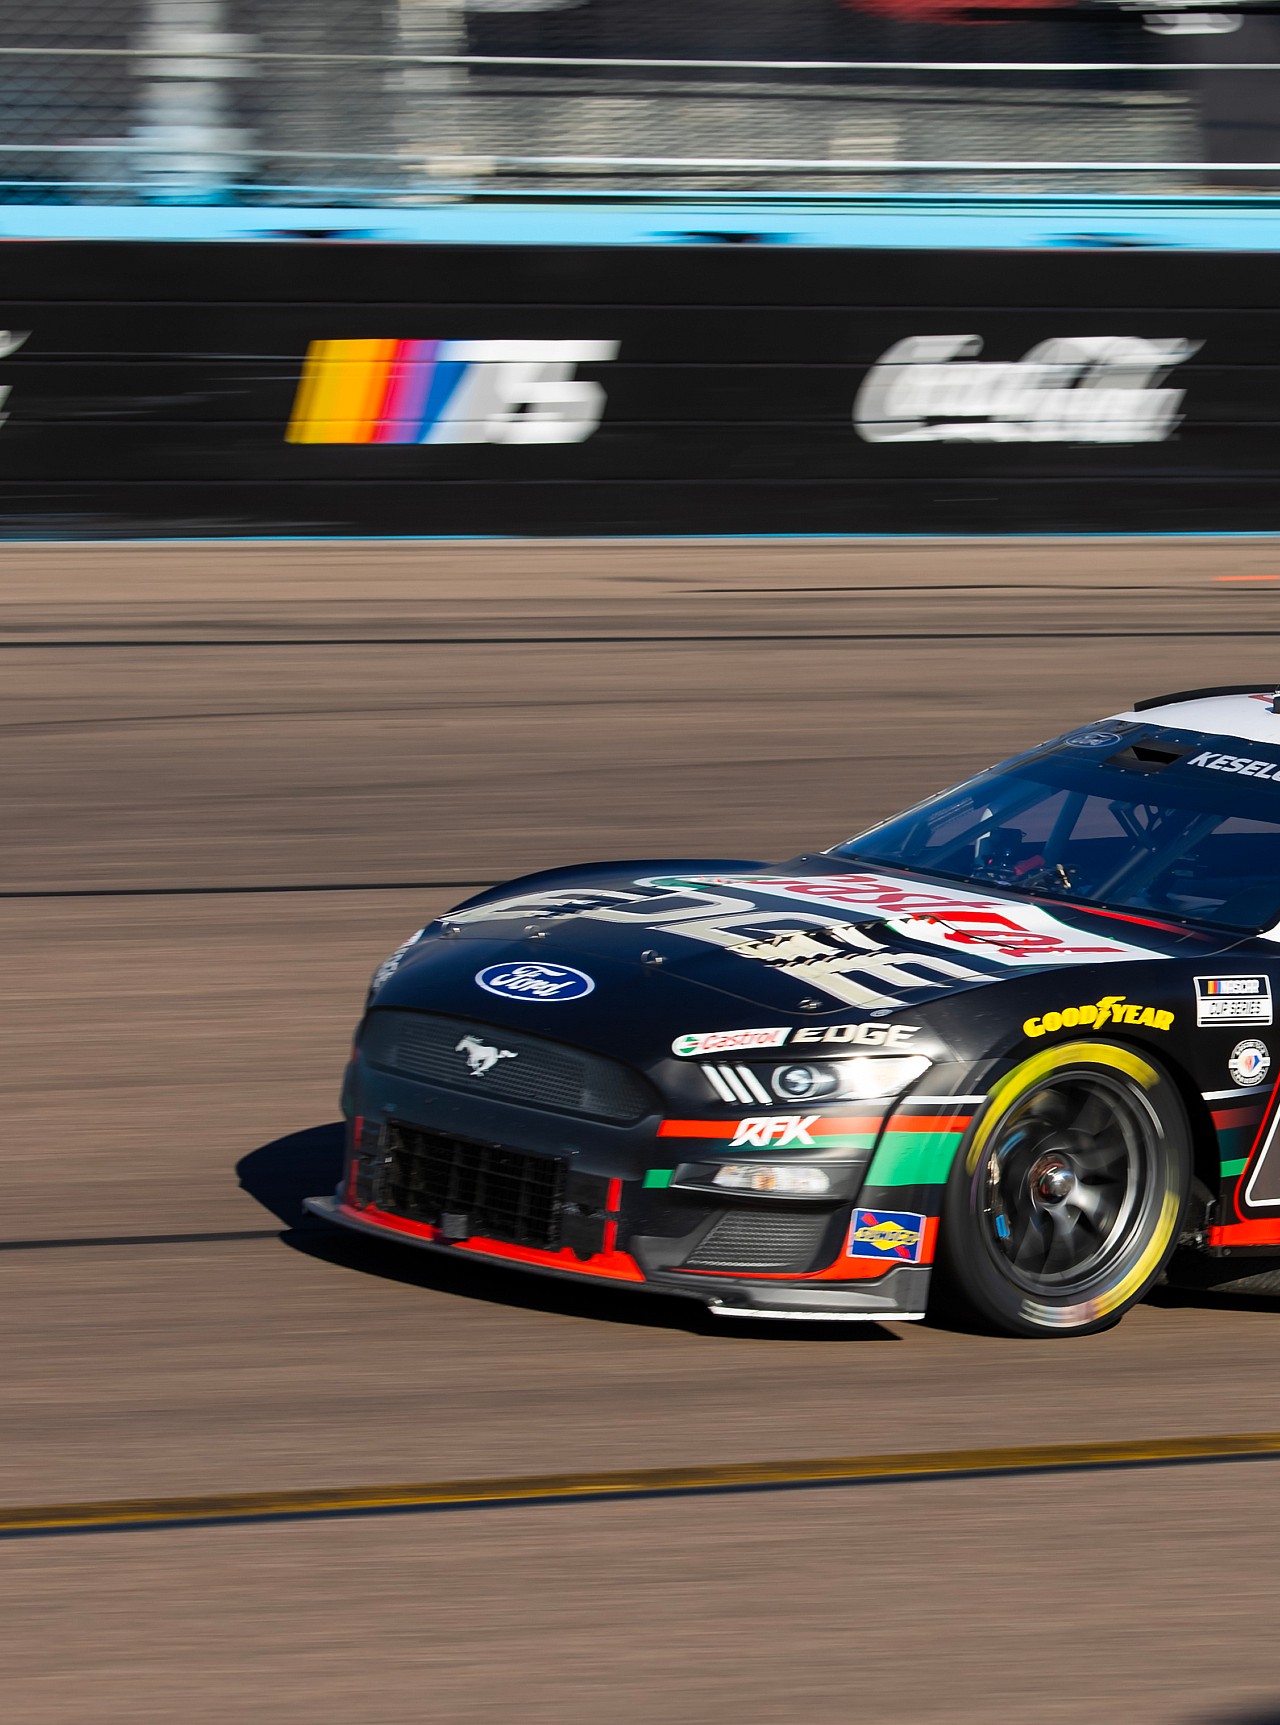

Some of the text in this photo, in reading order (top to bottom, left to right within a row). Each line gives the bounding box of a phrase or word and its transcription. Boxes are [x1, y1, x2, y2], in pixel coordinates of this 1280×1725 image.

[490, 965, 576, 997] Ford
[701, 1023, 923, 1050] Castrol EDGE
[728, 1115, 821, 1147] RFK
